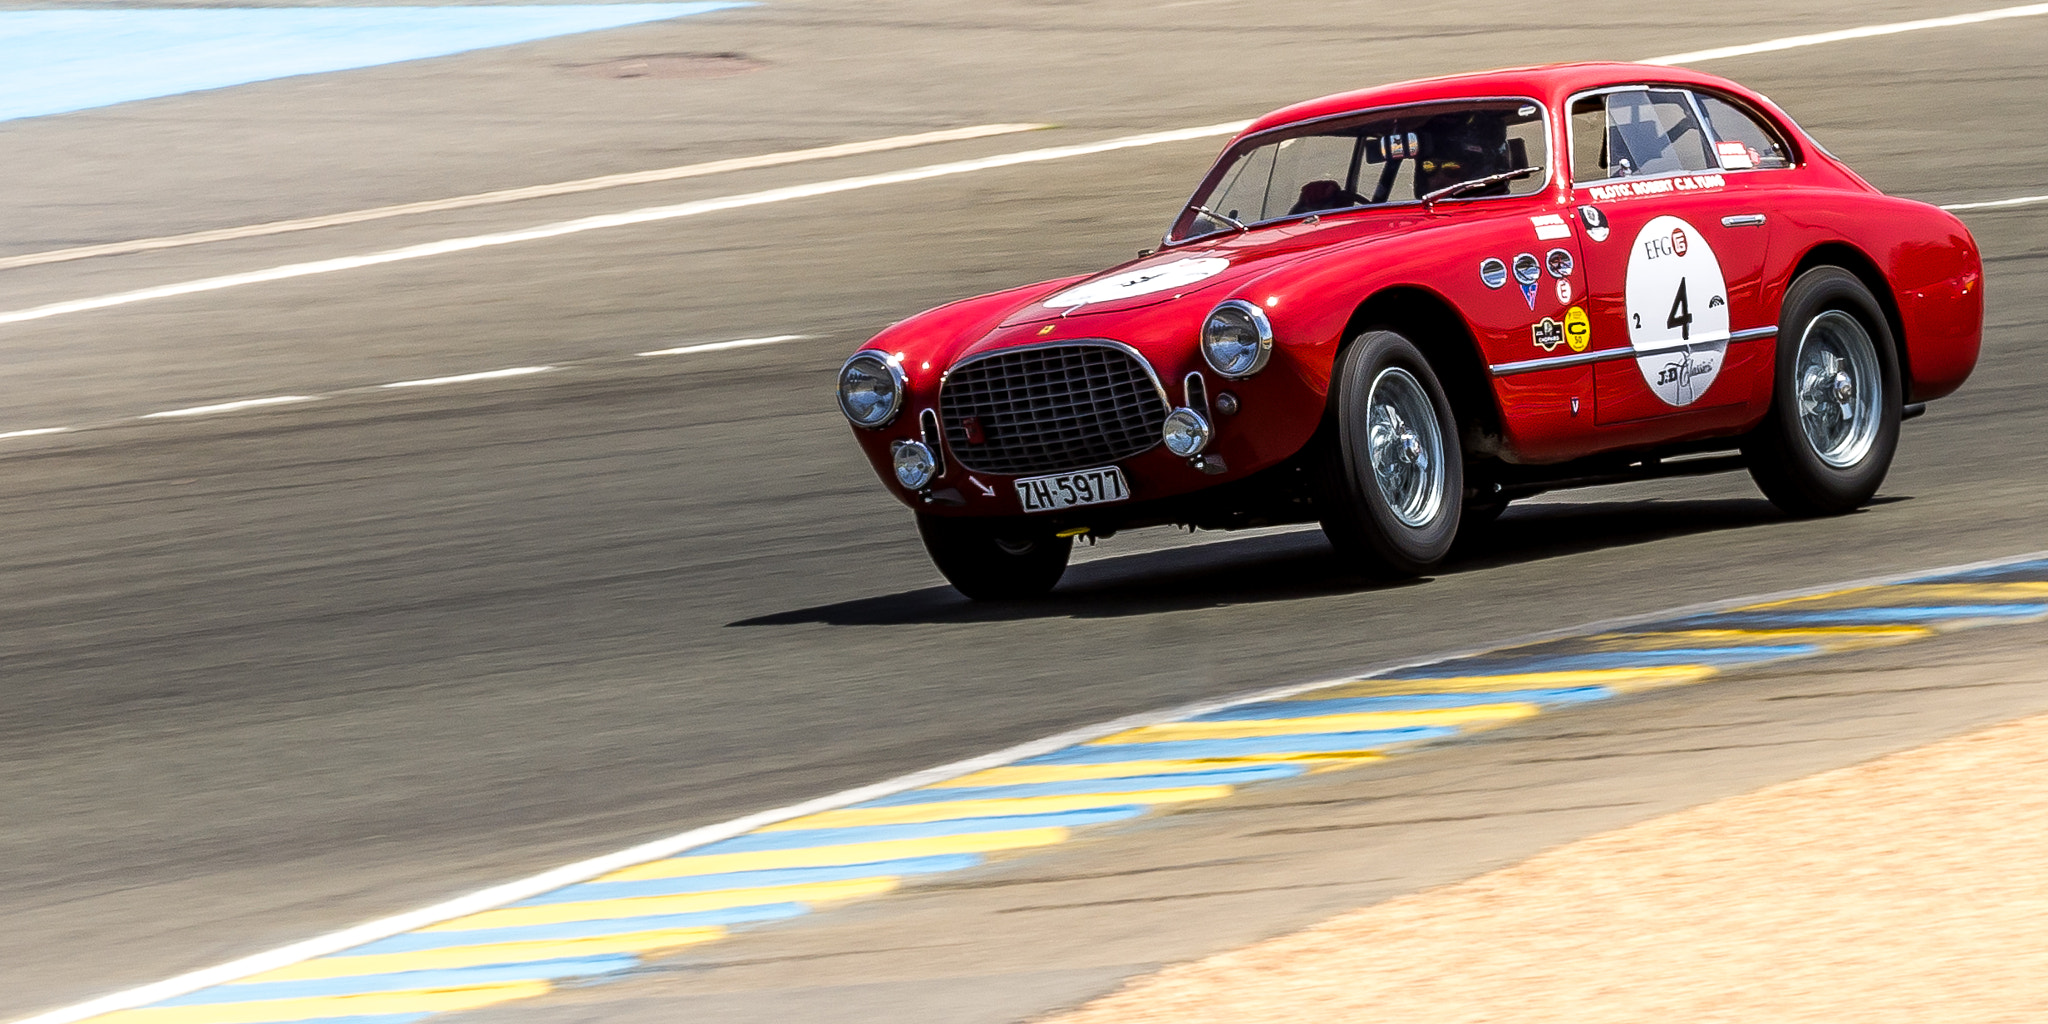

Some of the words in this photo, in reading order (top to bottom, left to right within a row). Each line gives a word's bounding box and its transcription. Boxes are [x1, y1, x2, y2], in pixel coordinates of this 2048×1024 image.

[1632, 179, 1674, 196] ROBERT
[1644, 236, 1672, 260] EFG
[1667, 276, 1693, 341] 4
[1568, 321, 1587, 335] C
[1632, 312, 1642, 329] 2
[1017, 470, 1123, 511] ZH-5977
